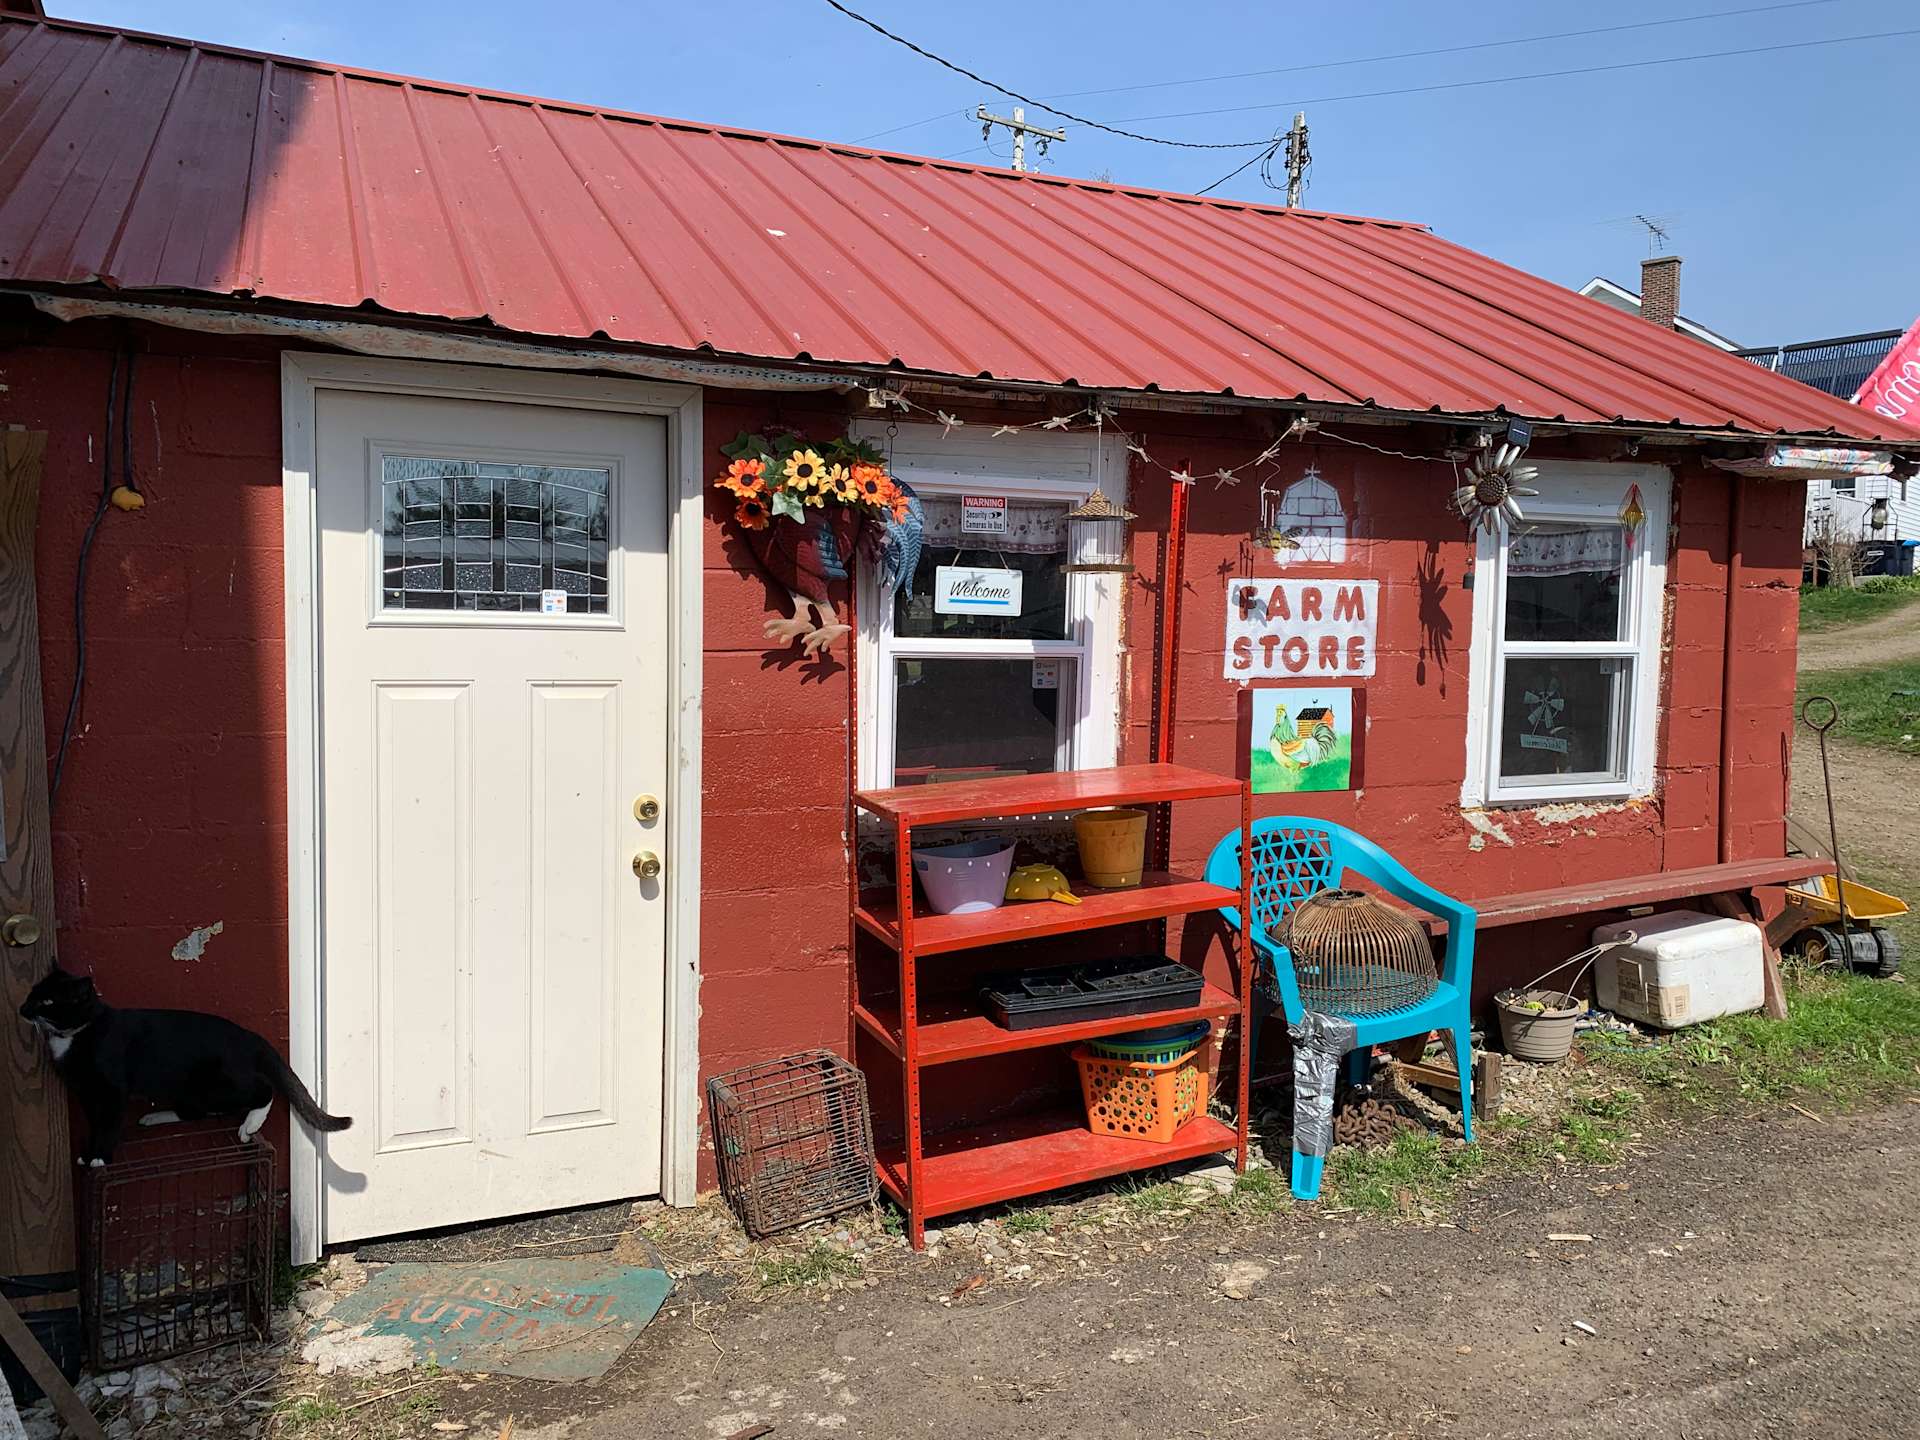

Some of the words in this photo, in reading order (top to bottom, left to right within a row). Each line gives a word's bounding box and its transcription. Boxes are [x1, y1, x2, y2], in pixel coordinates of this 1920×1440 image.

[965, 497, 1004, 508] WARNING
[966, 509, 987, 520] Security
[966, 520, 987, 529] Cameras
[949, 581, 1011, 599] Welcome
[1238, 584, 1367, 622] FARM
[1232, 634, 1366, 672] STORE
